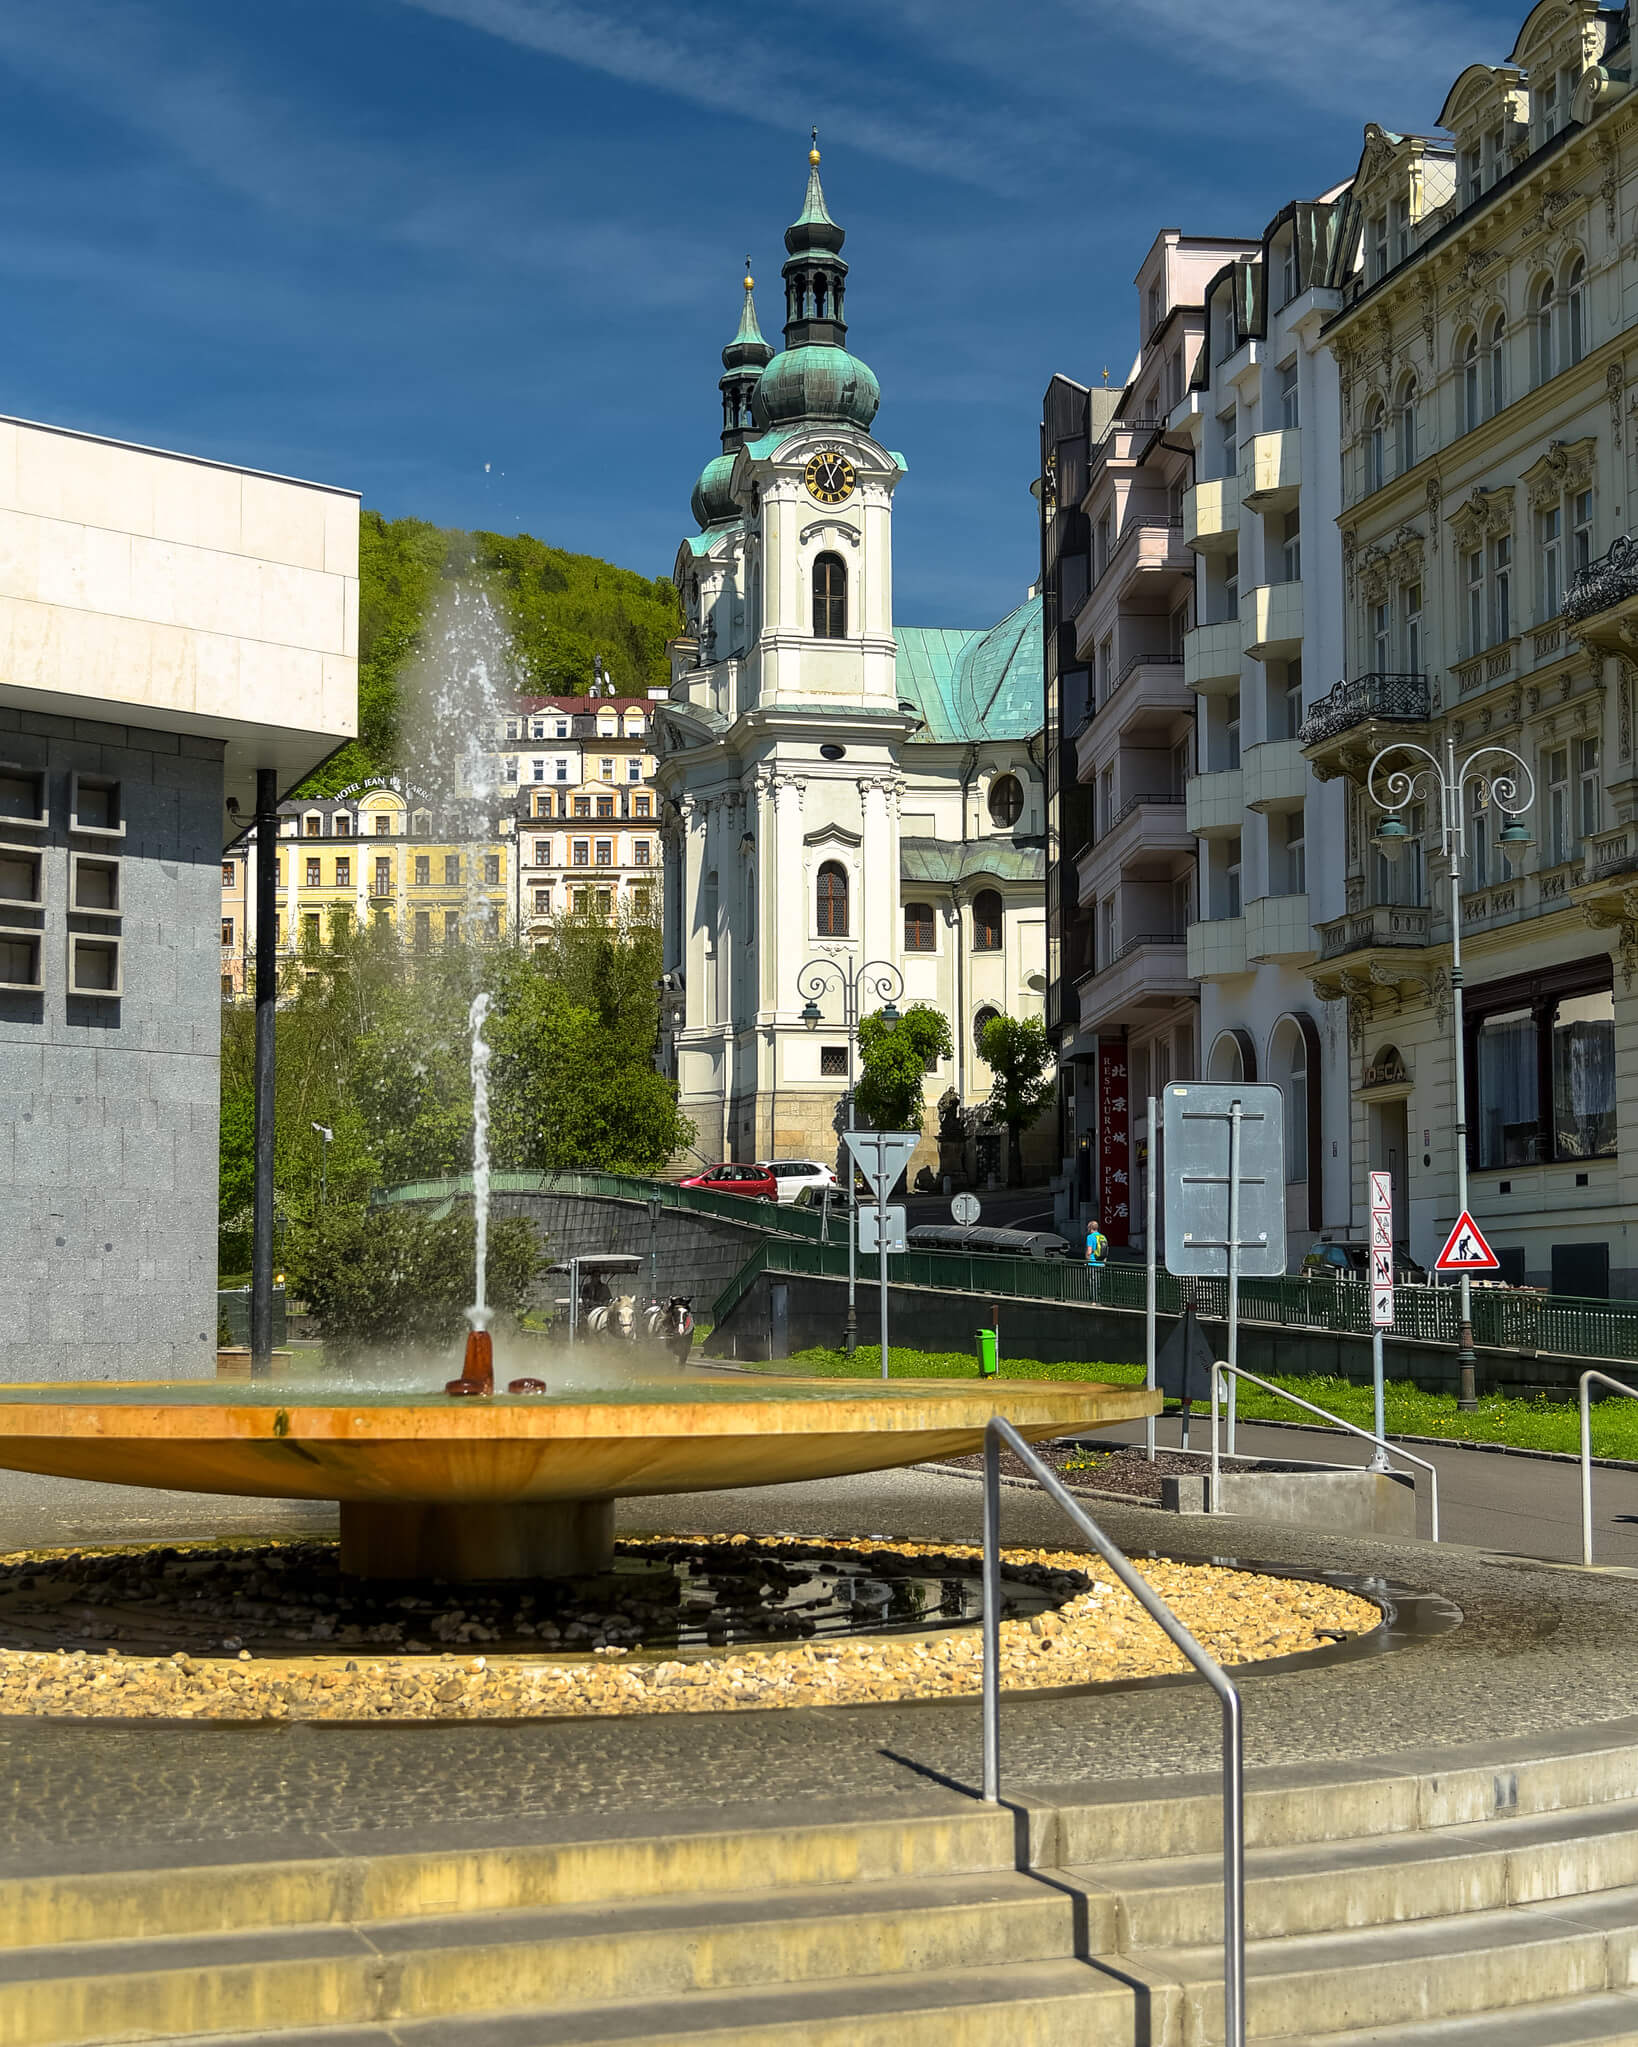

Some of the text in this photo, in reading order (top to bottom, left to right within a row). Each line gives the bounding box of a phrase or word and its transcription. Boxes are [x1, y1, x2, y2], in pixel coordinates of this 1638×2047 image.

[334, 782, 361, 802] HOTEL
[364, 777, 385, 788] JEAN
[1103, 1057, 1113, 1225] RESTAURACE PEKING
